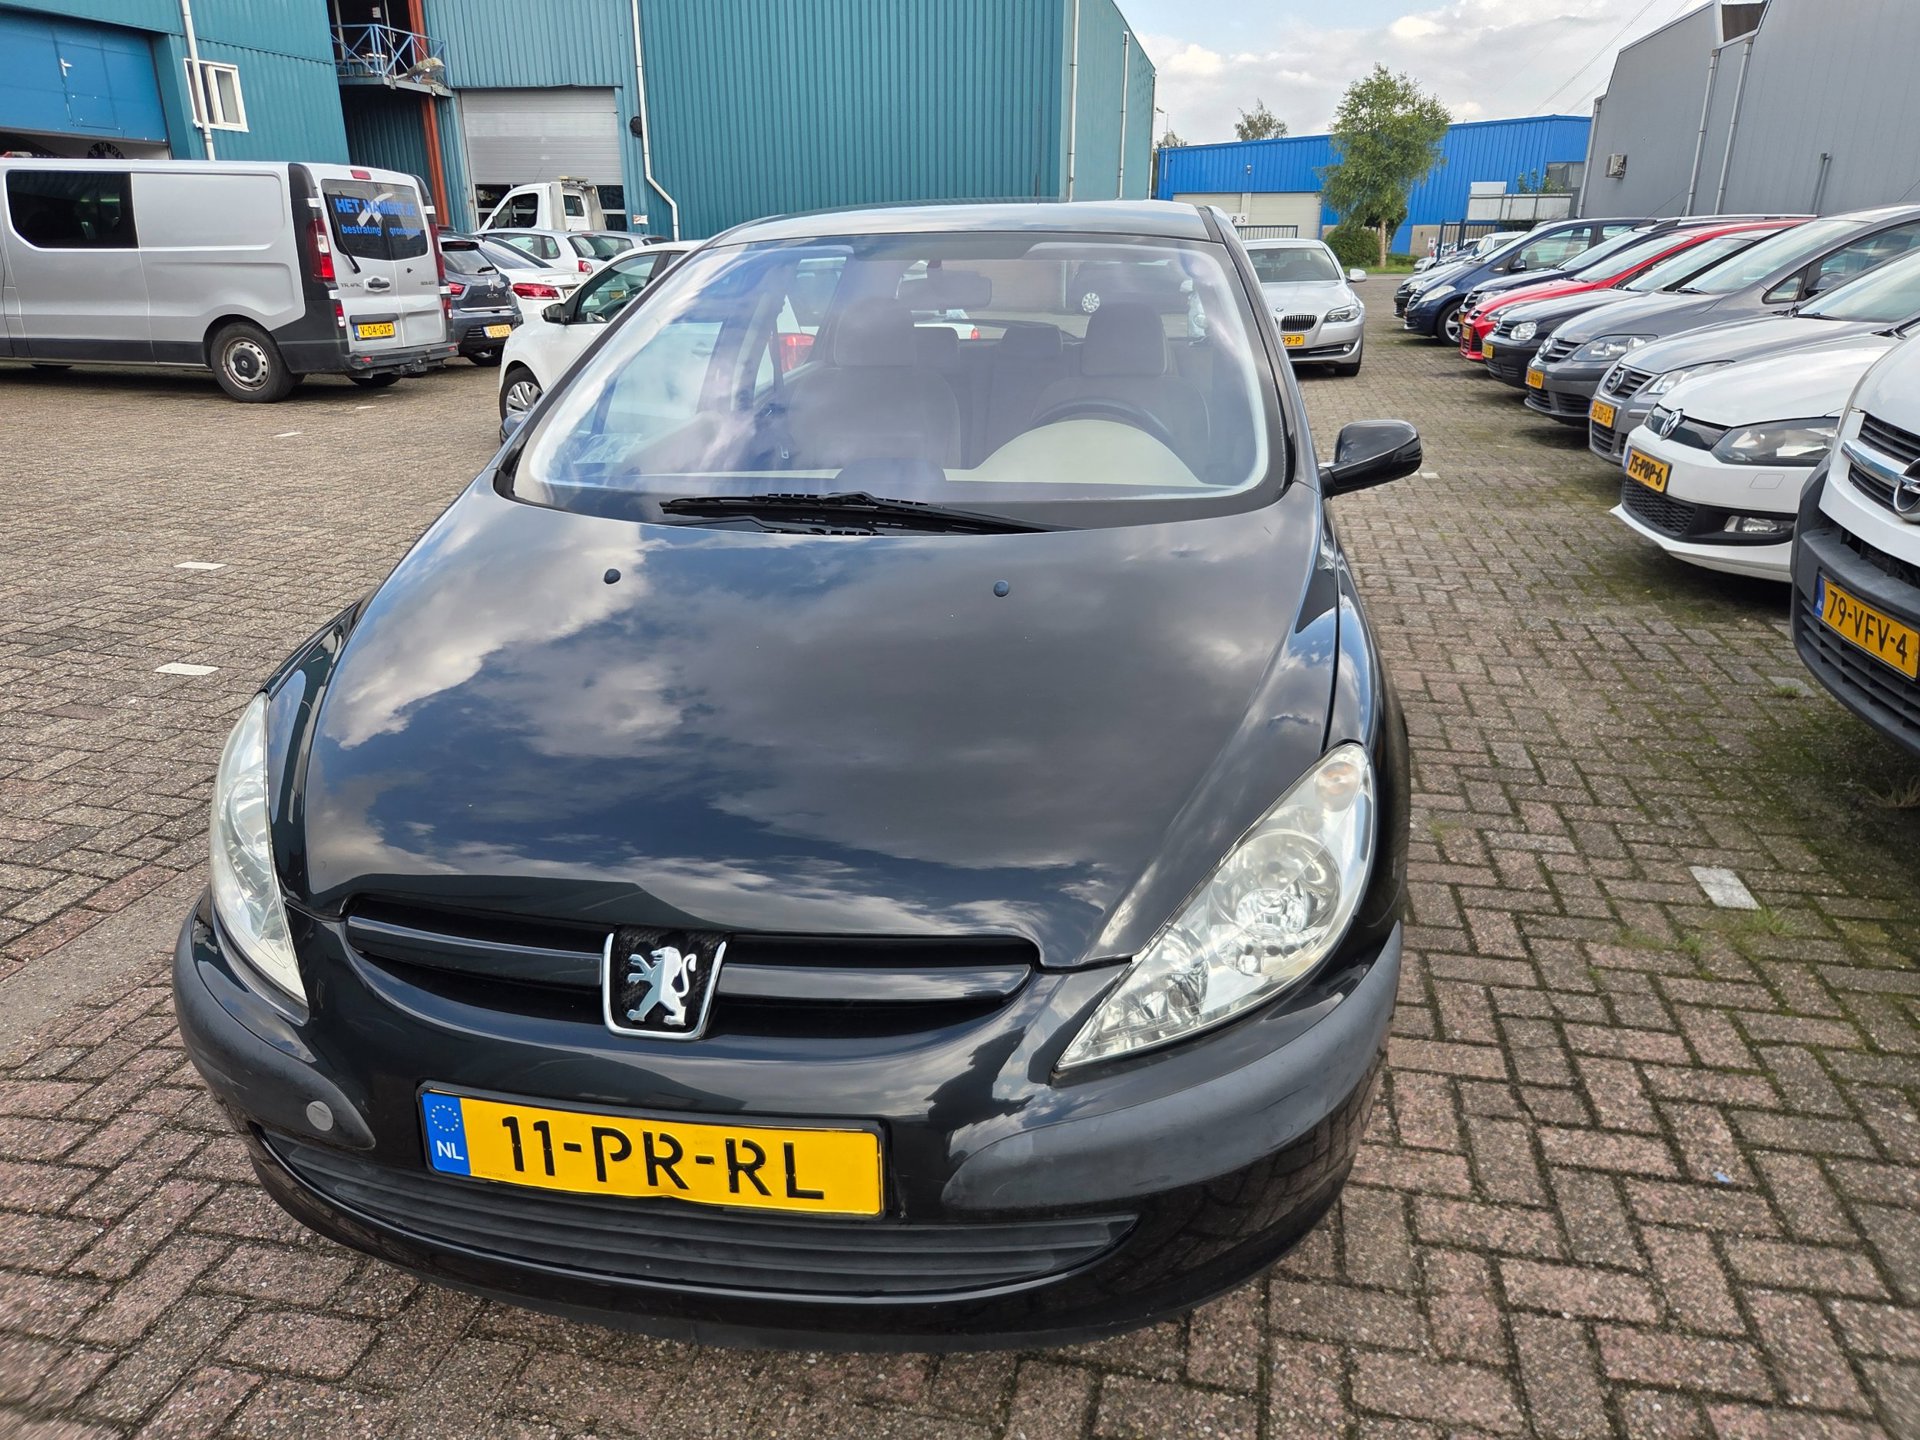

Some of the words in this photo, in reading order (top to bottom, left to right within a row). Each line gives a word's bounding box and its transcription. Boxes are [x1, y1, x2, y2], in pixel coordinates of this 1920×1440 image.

[335, 198, 360, 213] HET
[341, 224, 382, 236] bestrating
[359, 325, 392, 336] V-04-GXF
[1828, 589, 1908, 666] 79-VFV-4
[436, 1140, 465, 1160] NL
[502, 1115, 825, 1200] 11-PR-RL
